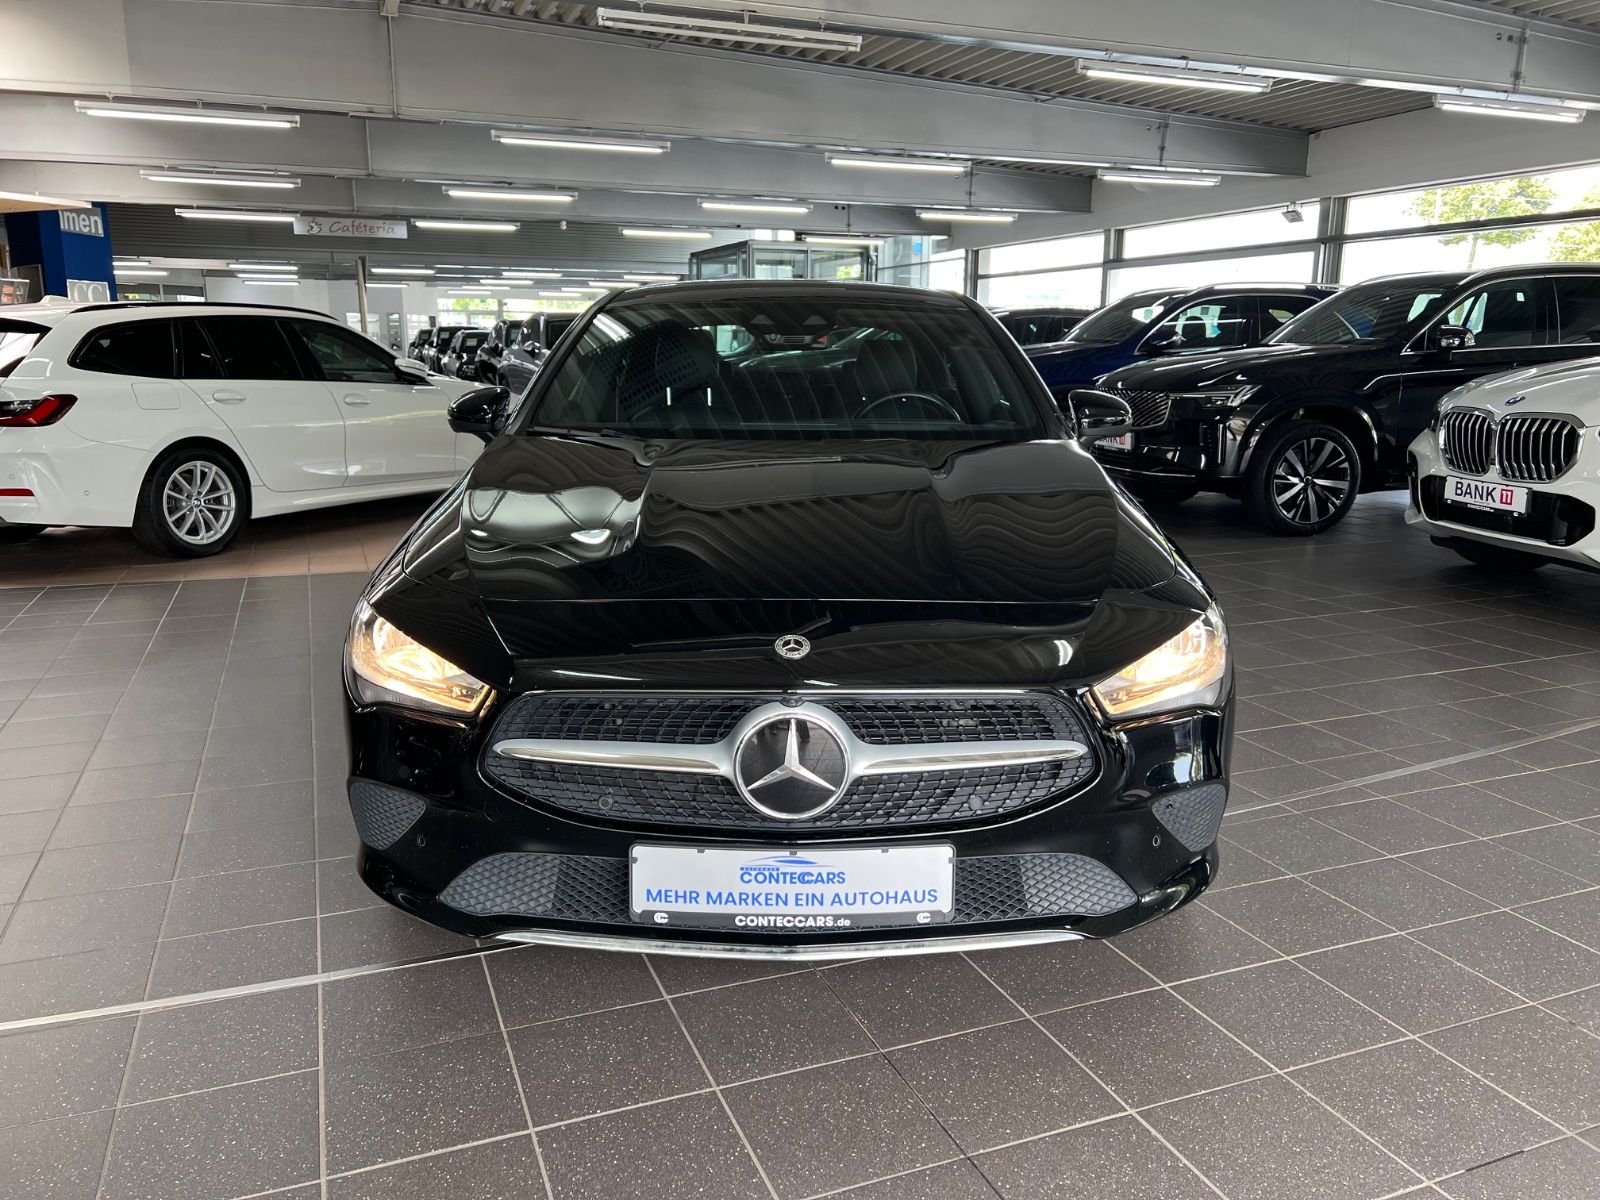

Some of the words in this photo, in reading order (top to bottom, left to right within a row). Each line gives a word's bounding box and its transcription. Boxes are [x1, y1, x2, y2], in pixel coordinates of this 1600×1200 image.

[1455, 481, 1496, 503] BANK
[1501, 489, 1512, 505] 11
[740, 871, 846, 885] CONTECCARS
[646, 888, 700, 904] MEHR
[706, 891, 788, 907] MARKEN
[794, 892, 824, 907] EIN
[830, 888, 938, 907] AUTOHAUS
[734, 915, 851, 927] CONTECCARS.de
